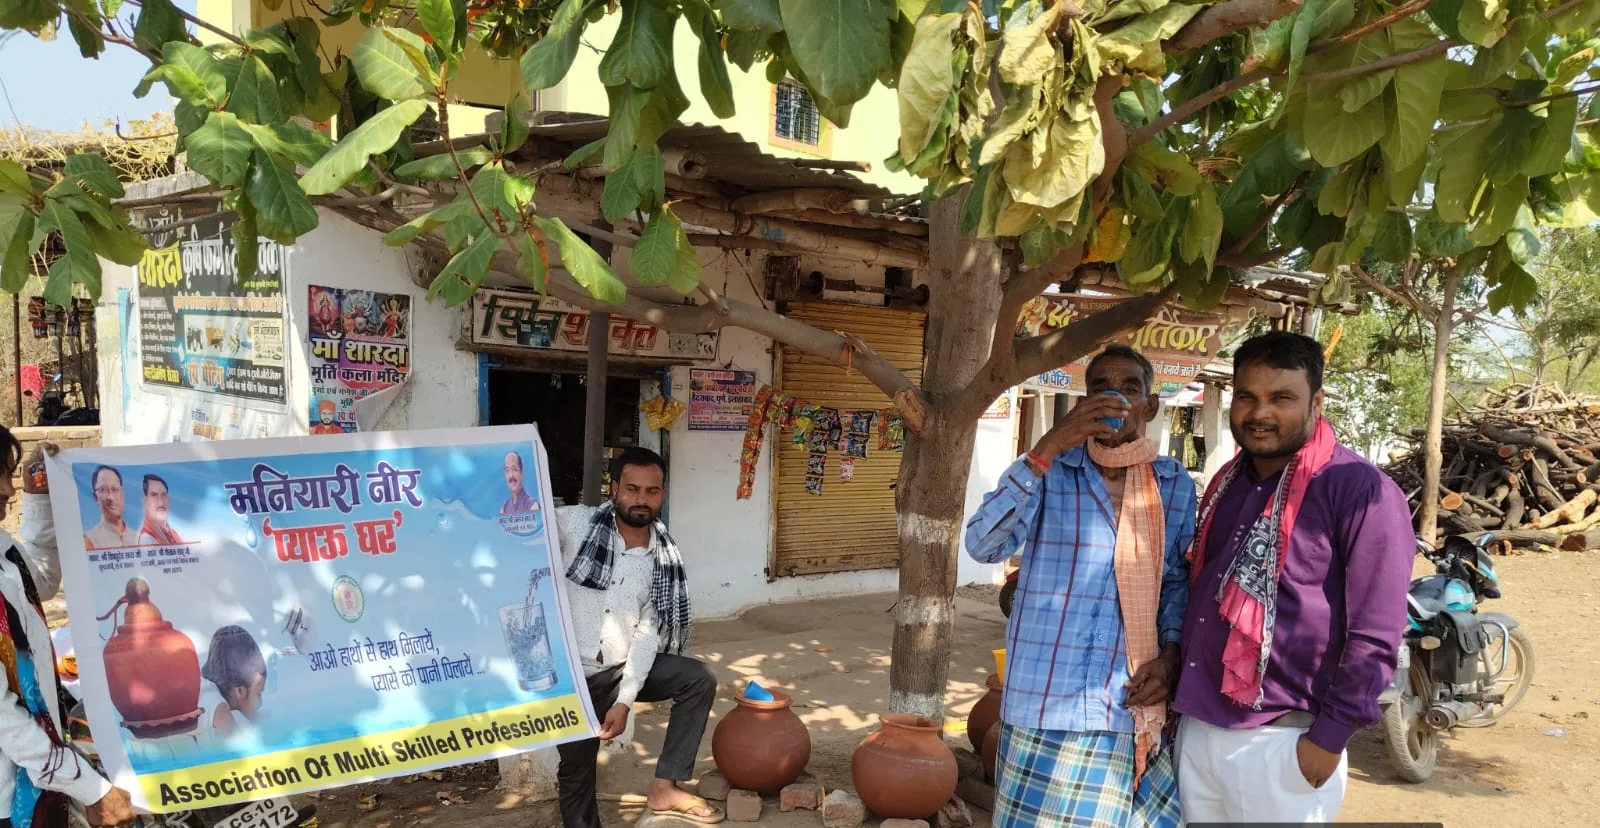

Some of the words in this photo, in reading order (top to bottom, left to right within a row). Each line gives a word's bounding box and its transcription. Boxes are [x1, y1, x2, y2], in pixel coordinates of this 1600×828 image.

[345, 340, 407, 367] शारदा
[342, 368, 372, 382] कला
[224, 462, 361, 514] मनियारी
[366, 460, 423, 508] नीर
[308, 643, 338, 672] आओ
[338, 639, 364, 667] हाथों
[364, 637, 377, 662] से
[377, 639, 400, 660] हाथ
[371, 665, 400, 692] प्यासे
[400, 663, 418, 687] को
[417, 658, 442, 685] पानी
[159, 765, 302, 806] Association
[304, 754, 332, 780] Of
[333, 744, 390, 775] Multi
[391, 730, 462, 763] Skilled
[461, 706, 580, 748] Professionals
